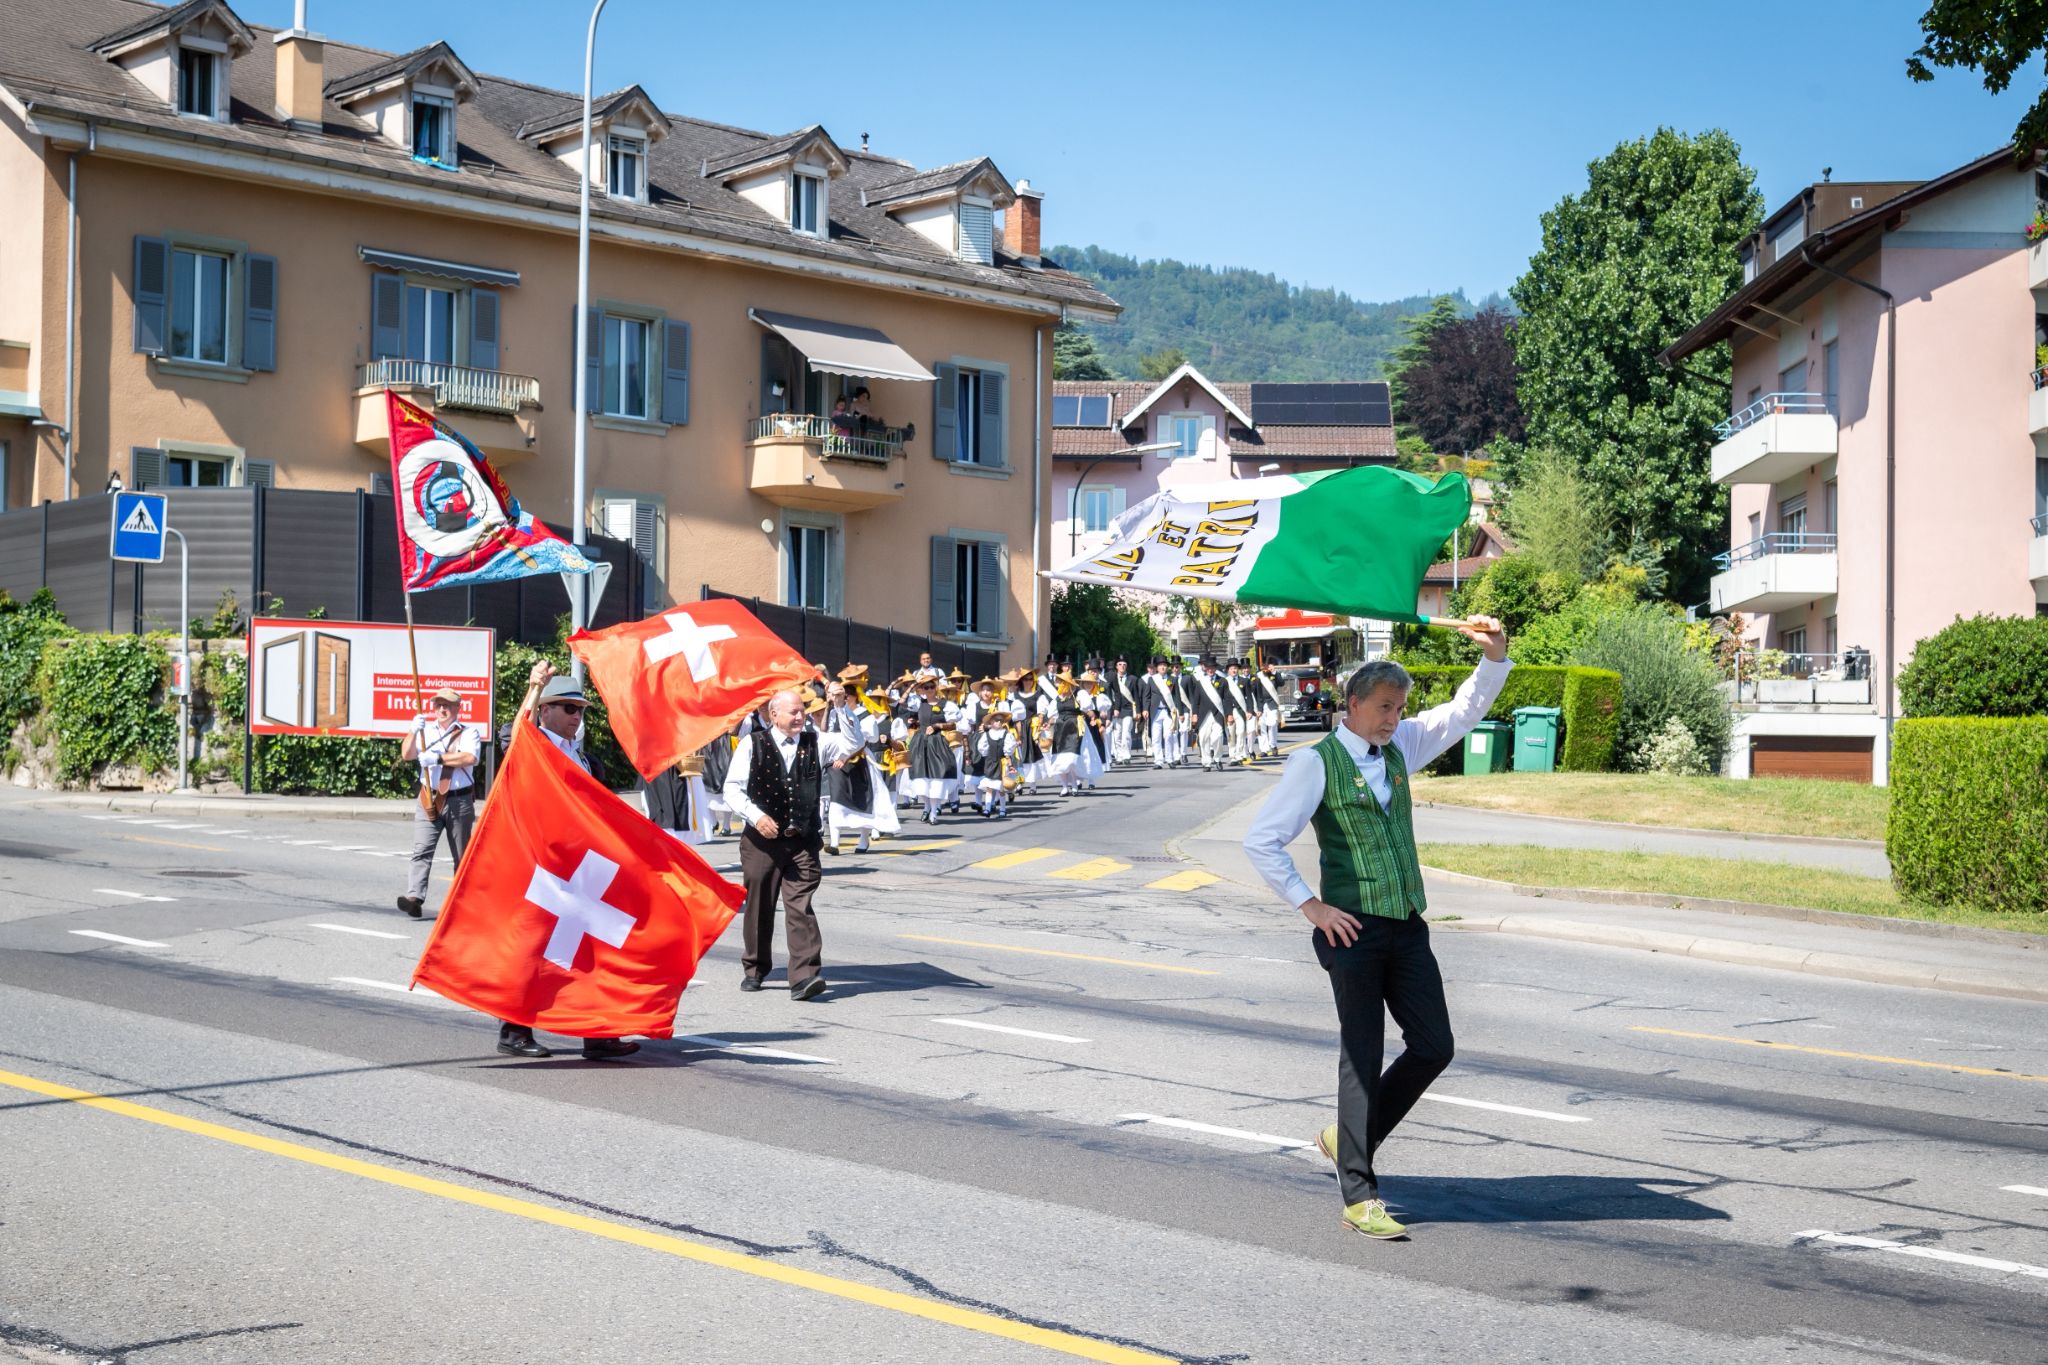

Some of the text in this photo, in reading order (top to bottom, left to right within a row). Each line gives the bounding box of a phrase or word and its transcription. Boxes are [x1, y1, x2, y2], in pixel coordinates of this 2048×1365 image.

[1157, 520, 1191, 548] ET
[377, 676, 422, 688] Internor,
[425, 678, 479, 688] évidemment
[387, 694, 472, 712] Interm
